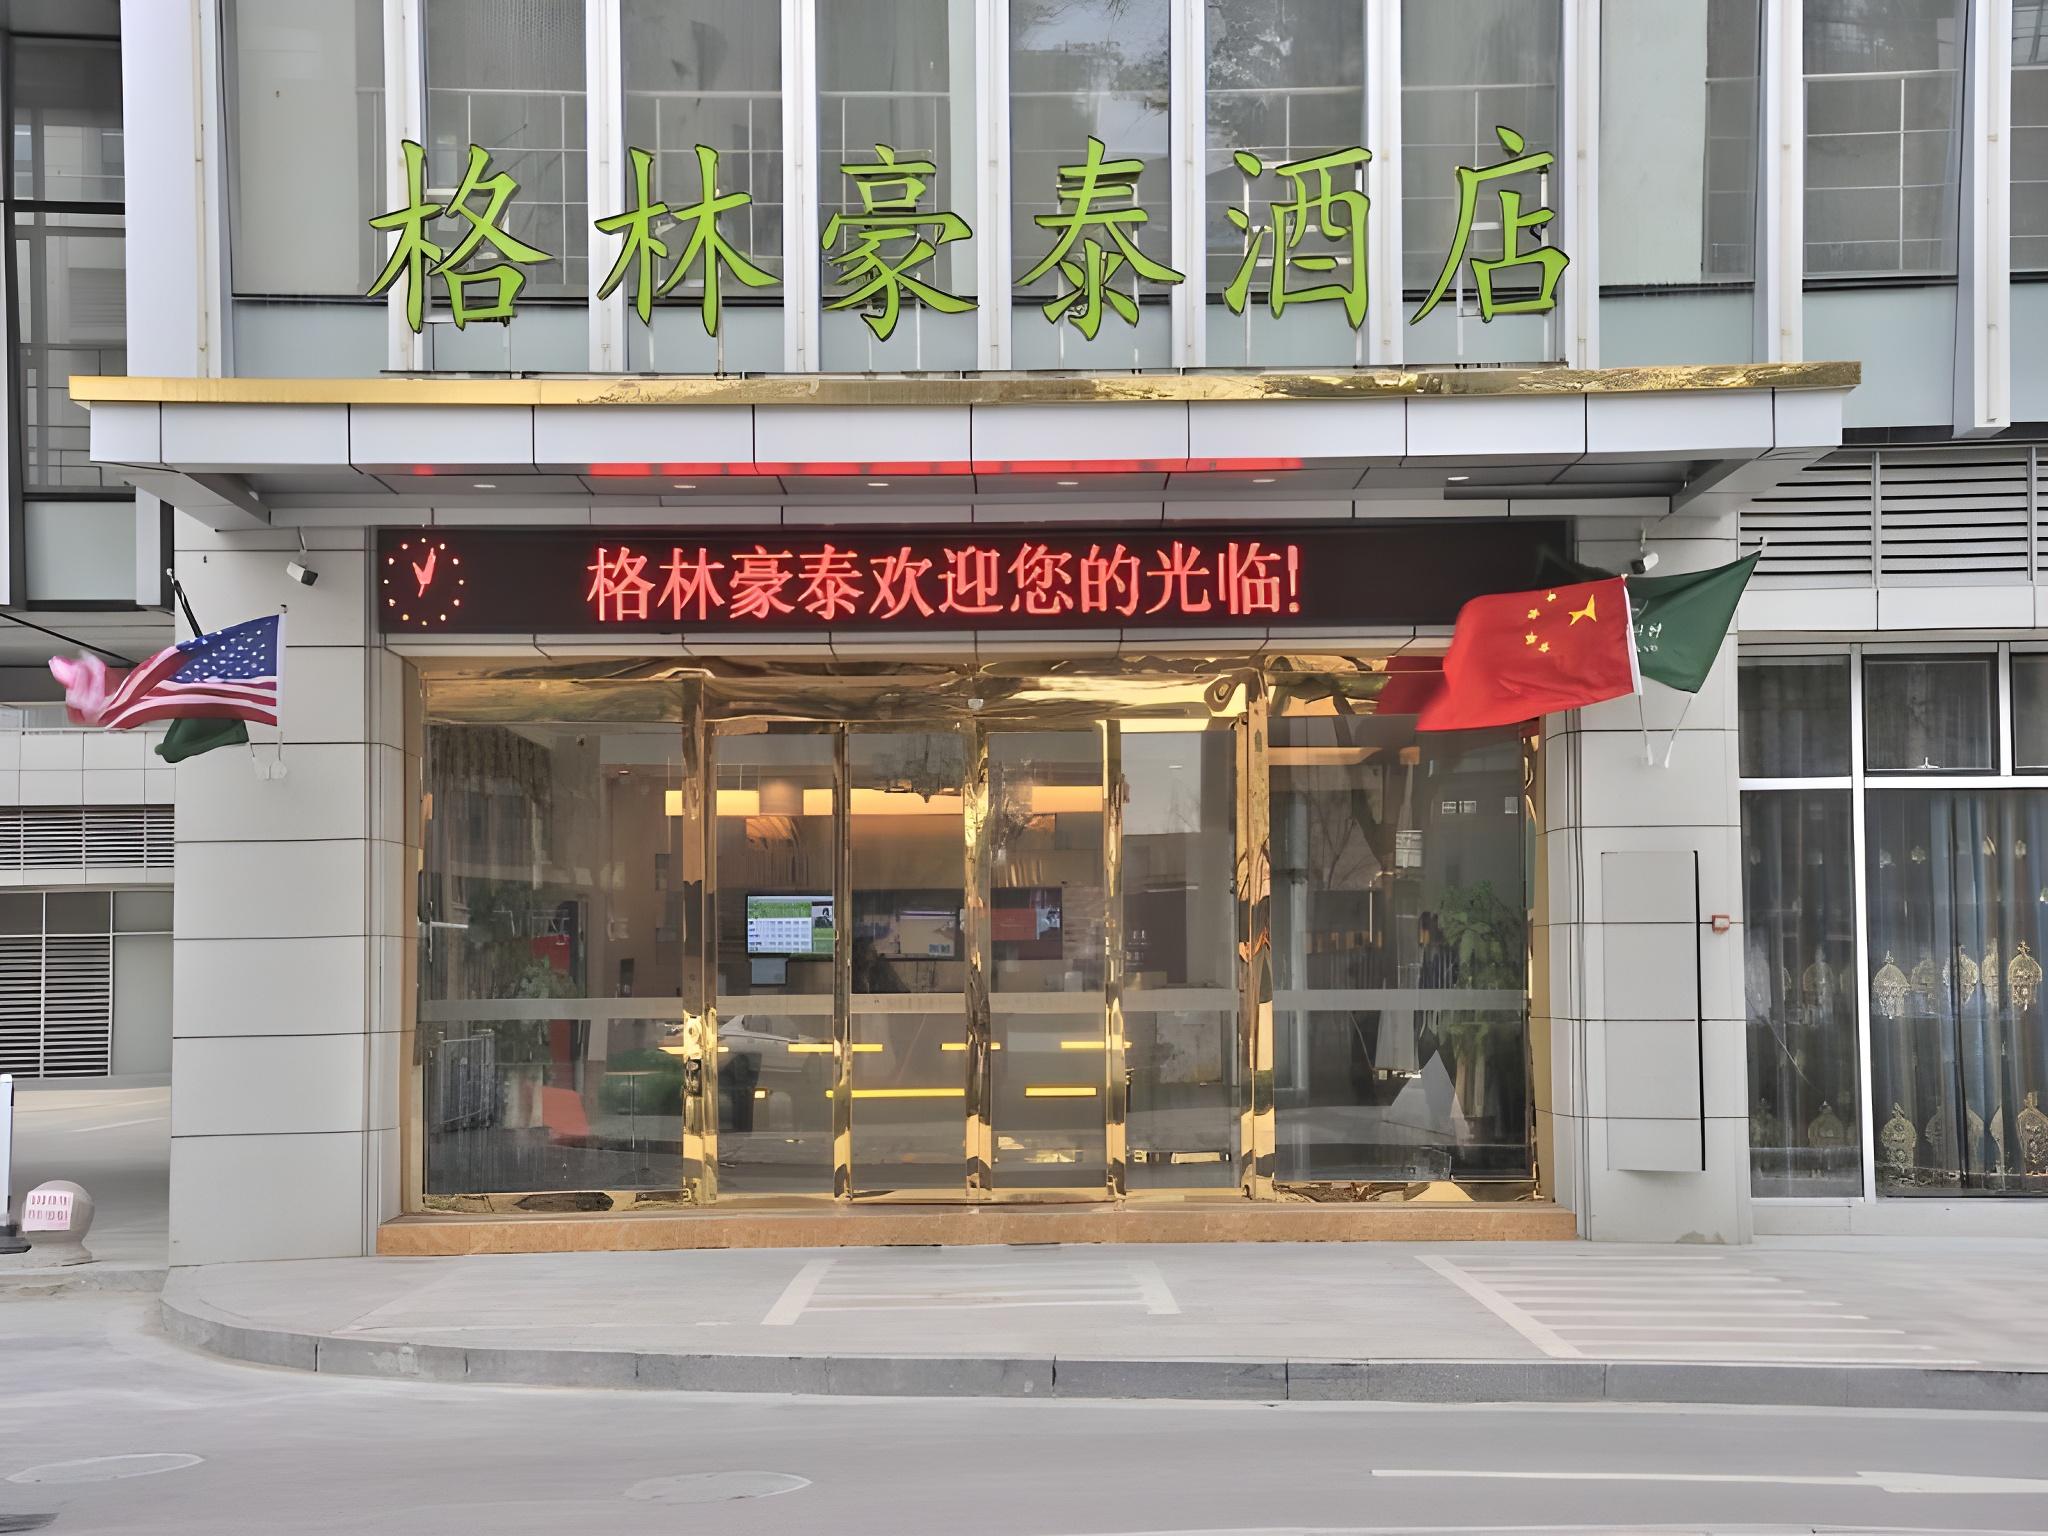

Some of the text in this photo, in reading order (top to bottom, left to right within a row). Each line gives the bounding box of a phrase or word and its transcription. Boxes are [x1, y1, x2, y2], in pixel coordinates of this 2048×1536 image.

[367, 126, 1570, 341] 格林豪泰酒店
[587, 542, 1301, 621] 格林豪泰欢迎您的光临!
